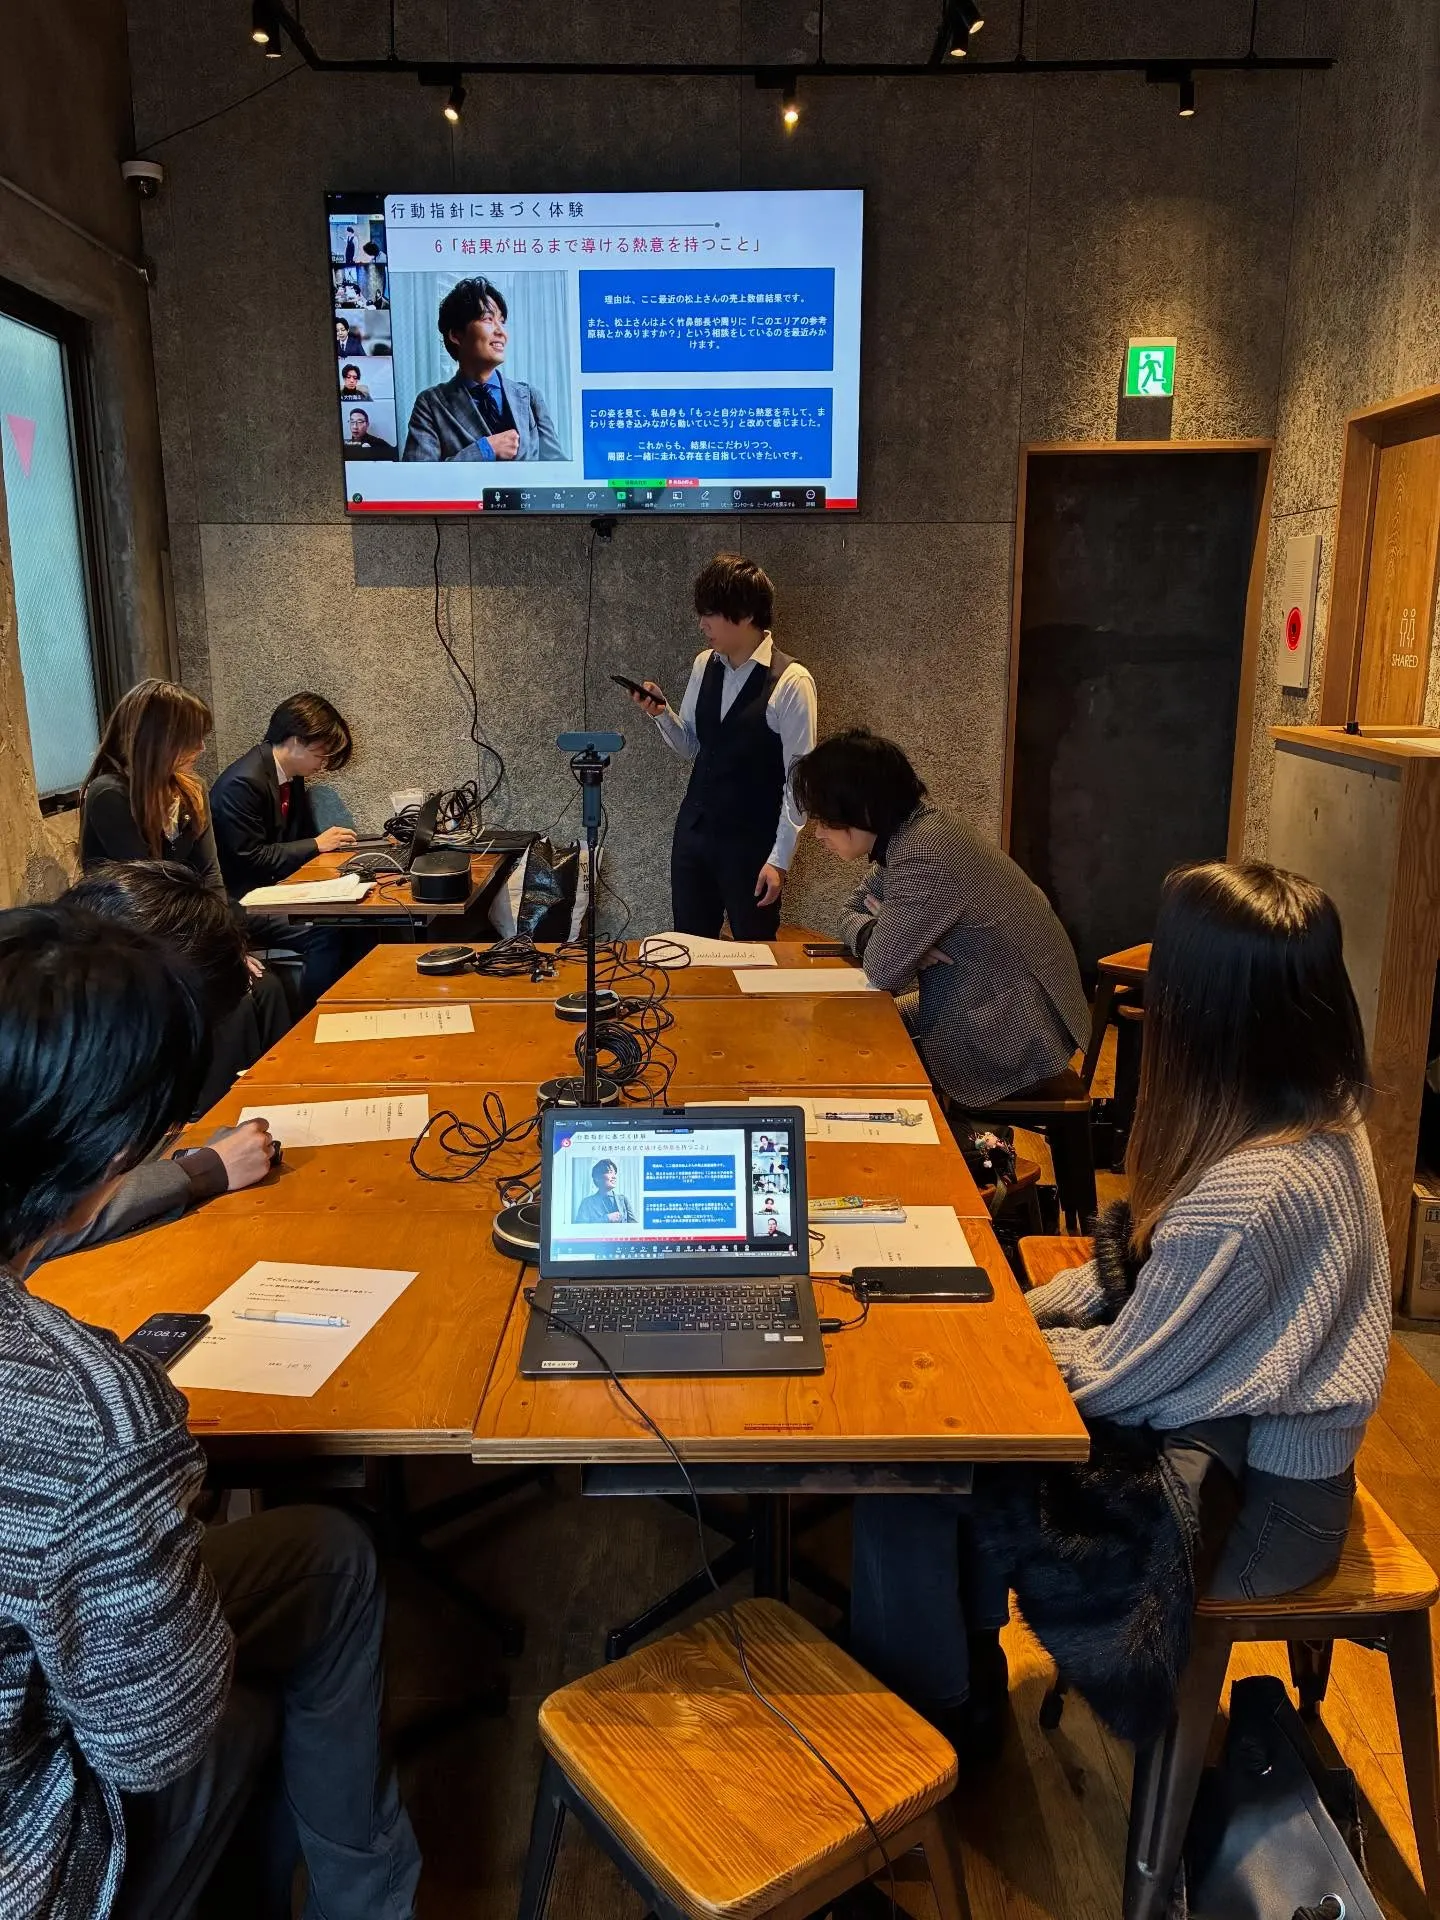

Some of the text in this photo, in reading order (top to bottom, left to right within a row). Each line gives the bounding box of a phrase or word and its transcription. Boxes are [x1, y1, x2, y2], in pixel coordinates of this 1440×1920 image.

[391, 201, 584, 219] 行動指針に基づく体験
[435, 236, 761, 254] 6「結果が出るまで導ける熱意を持つこと」
[689, 340, 721, 350] けます。
[638, 440, 774, 451] これからも、結果にこだわりつつ、
[1391, 653, 1419, 668] SHARED
